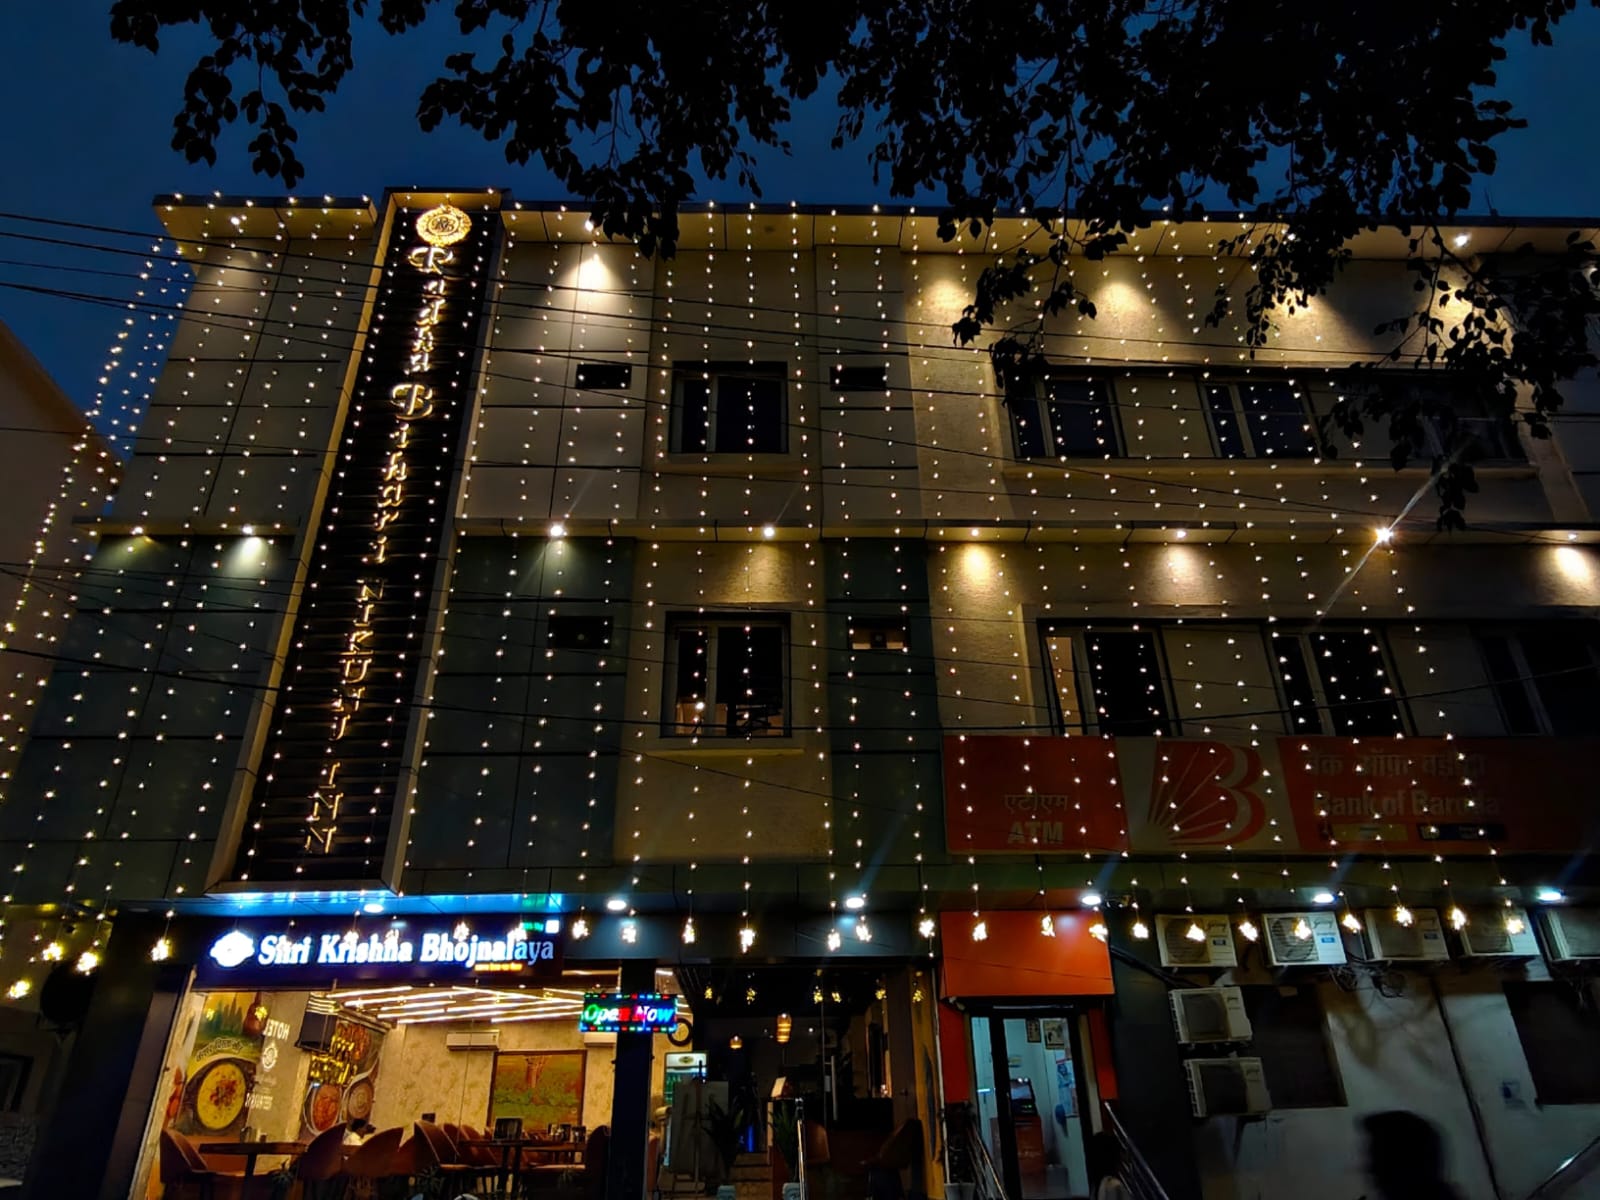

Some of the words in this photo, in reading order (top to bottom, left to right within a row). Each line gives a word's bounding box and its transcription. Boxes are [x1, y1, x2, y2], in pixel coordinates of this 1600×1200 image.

[381, 384, 433, 563] Bihari
[304, 761, 344, 854] INN
[1313, 789, 1377, 817] Bank
[1381, 788, 1406, 817] of
[1008, 821, 1064, 846] ATM
[258, 934, 312, 966] Shri
[318, 932, 414, 964] Krishna
[420, 931, 554, 969] Bhojnalaya
[584, 1003, 631, 1025] Open
[632, 1004, 674, 1022] Now
